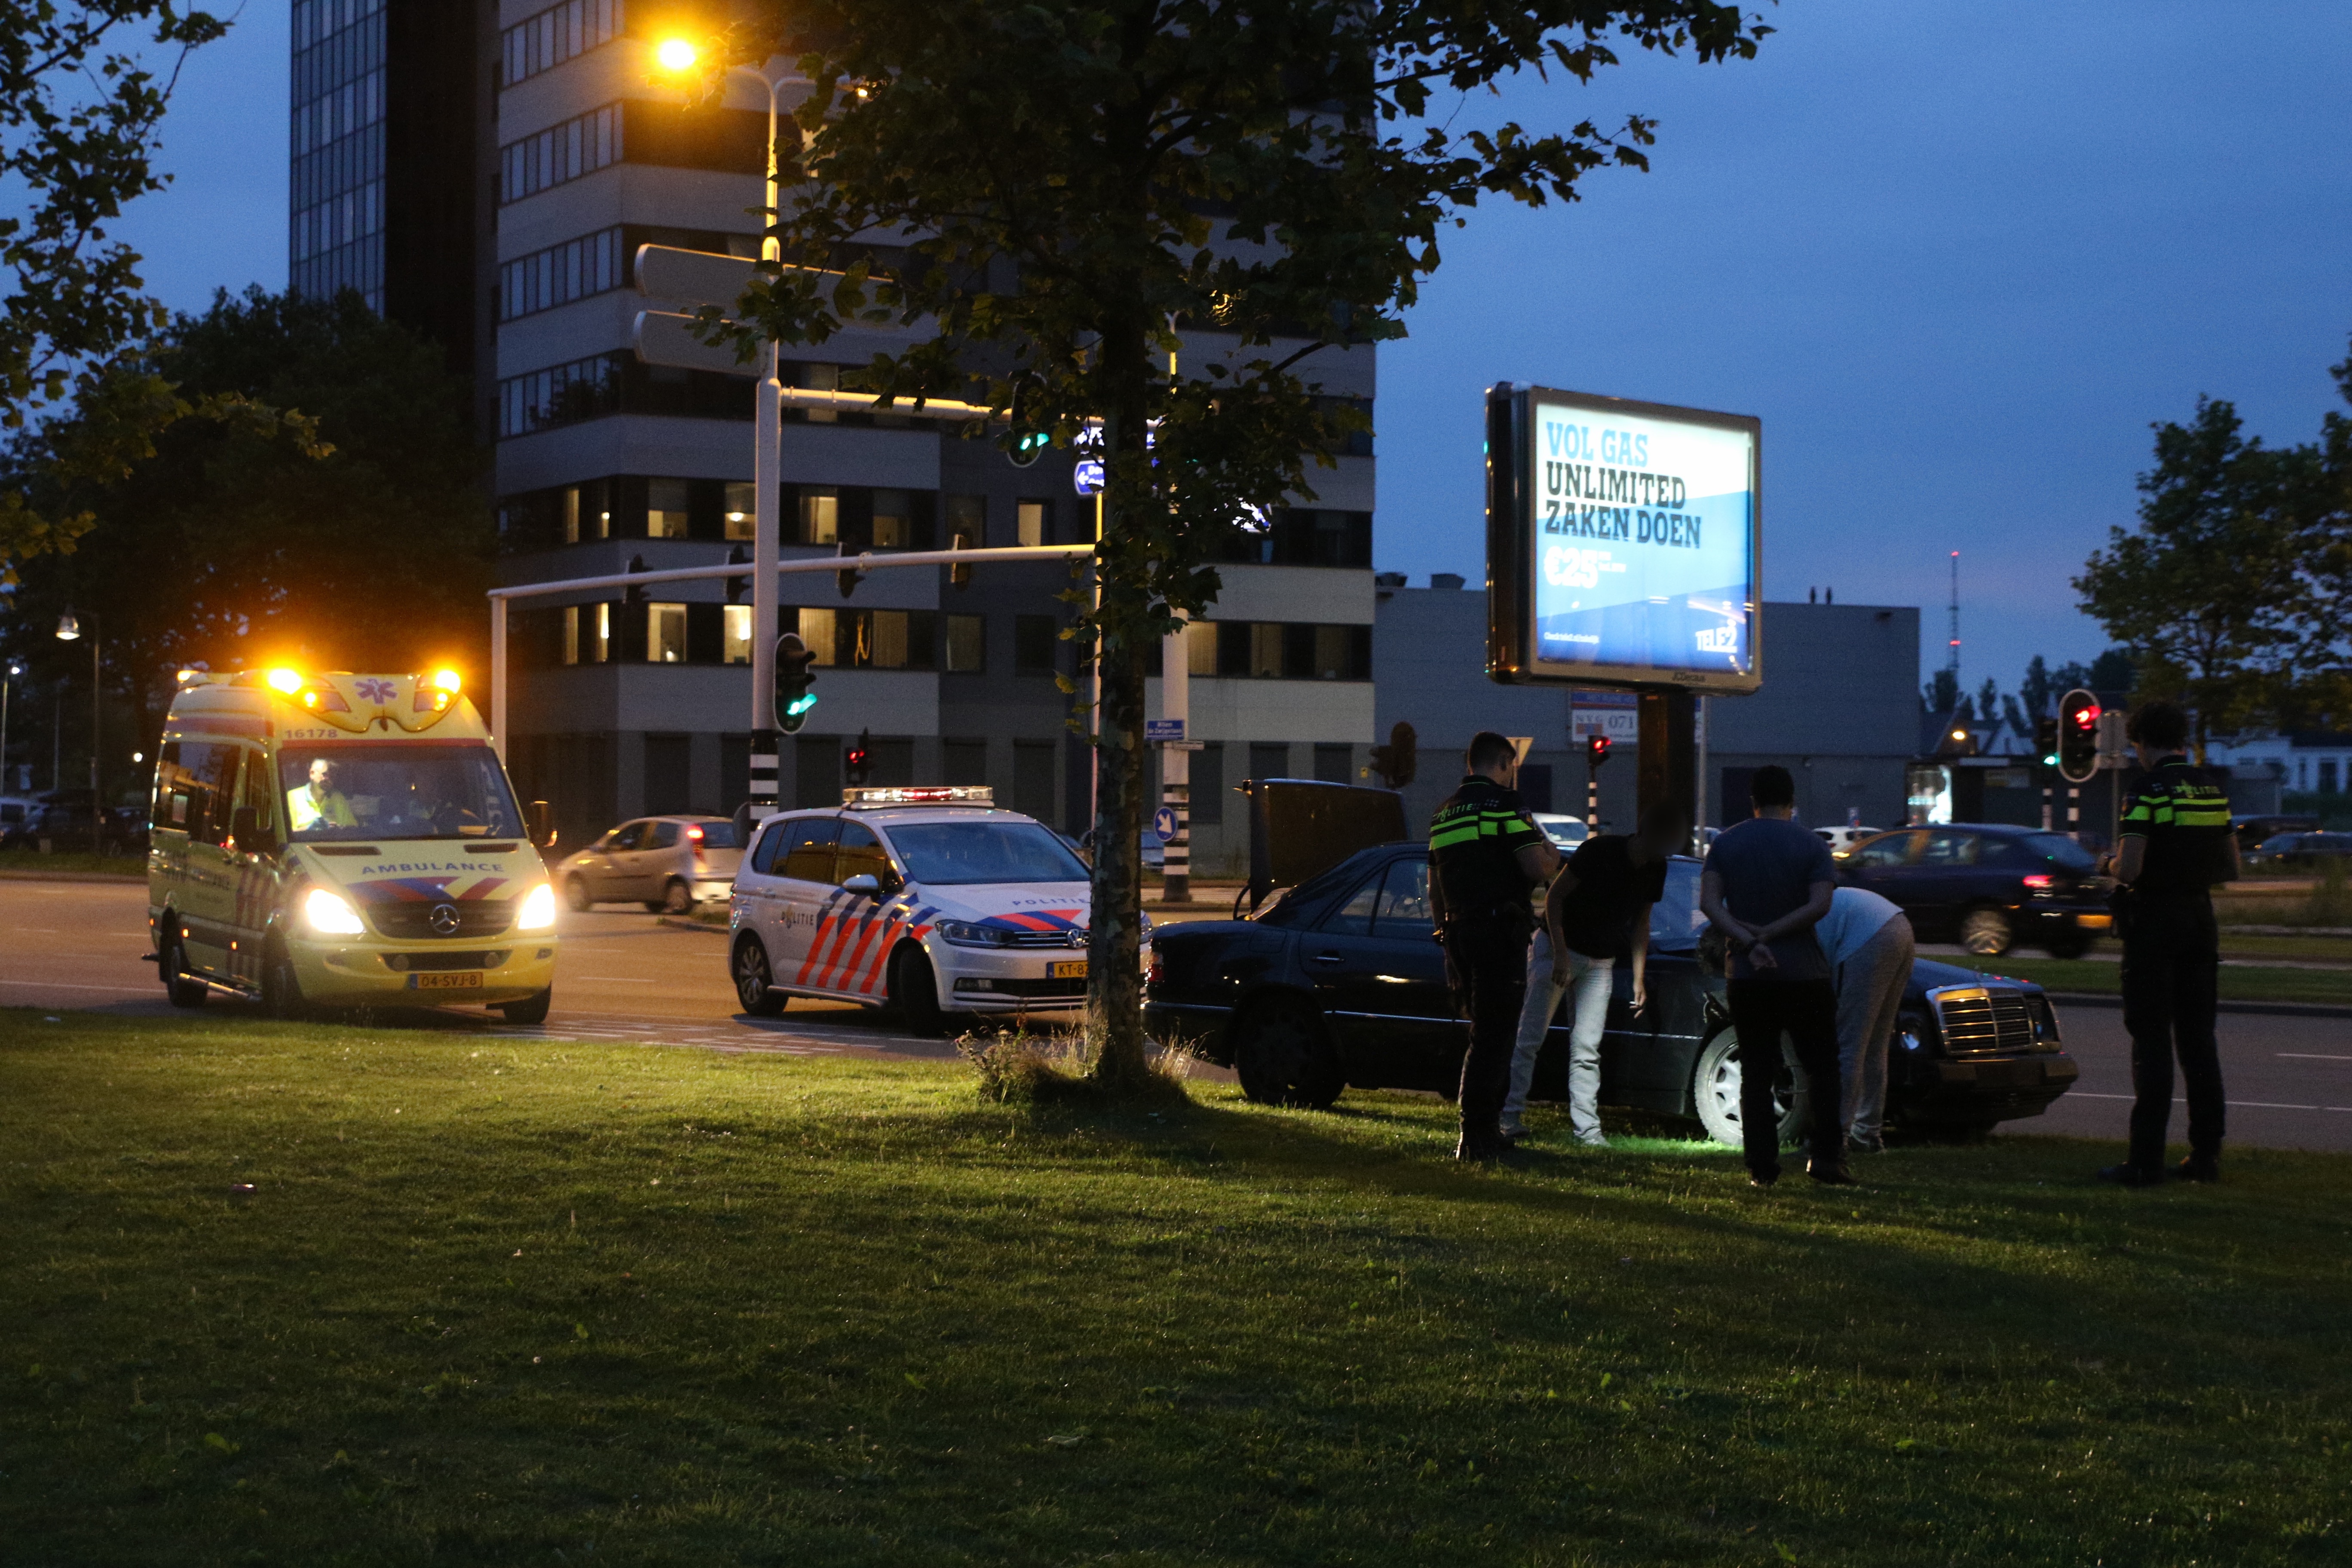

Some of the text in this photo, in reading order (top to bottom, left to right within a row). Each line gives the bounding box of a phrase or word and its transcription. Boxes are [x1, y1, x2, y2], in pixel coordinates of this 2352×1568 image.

[1546, 421, 1648, 468] VOL GAS
[1546, 460, 1686, 509] UNLIMITED
[1545, 499, 1701, 549] ZAKEN DOEN
[1544, 545, 1598, 588] €25
[1695, 626, 1737, 653] TELE2
[362, 863, 505, 874] AMBULANCE
[422, 975, 477, 987] 04-SVJ-8
